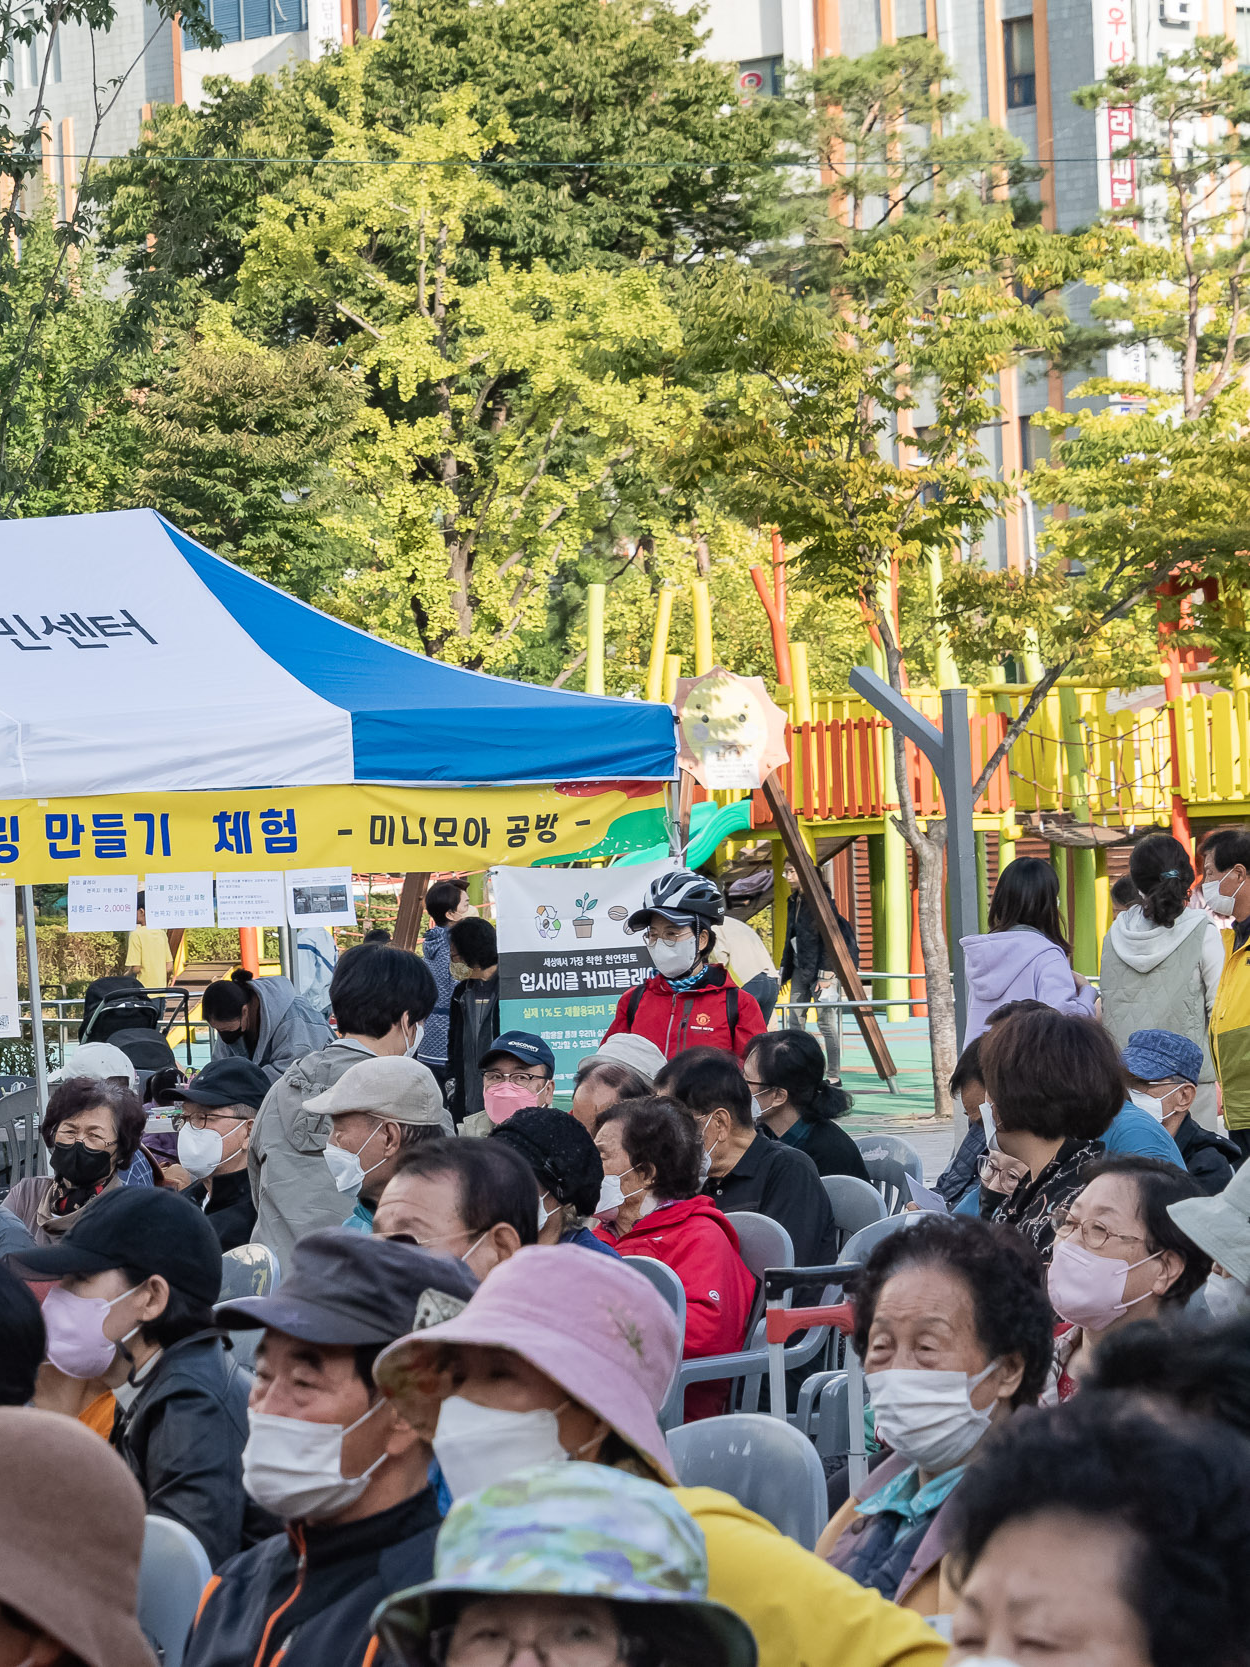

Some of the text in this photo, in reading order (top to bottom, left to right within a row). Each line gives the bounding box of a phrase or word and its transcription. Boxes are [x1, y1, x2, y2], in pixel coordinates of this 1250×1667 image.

[44, 813, 172, 860] 만들기
[212, 808, 298, 854] 체험
[369, 814, 491, 848] 미니모아
[506, 813, 559, 849] 공방
[543, 953, 638, 968] 세상에서 가장 착한 천연점토
[519, 971, 580, 992] 업사이클
[522, 1007, 539, 1019] 실제
[564, 1004, 605, 1018] 재활용되지
[578, 1028, 597, 1039] 우리가
[550, 1040, 571, 1050] 건강할
[572, 1040, 581, 1049] 수
